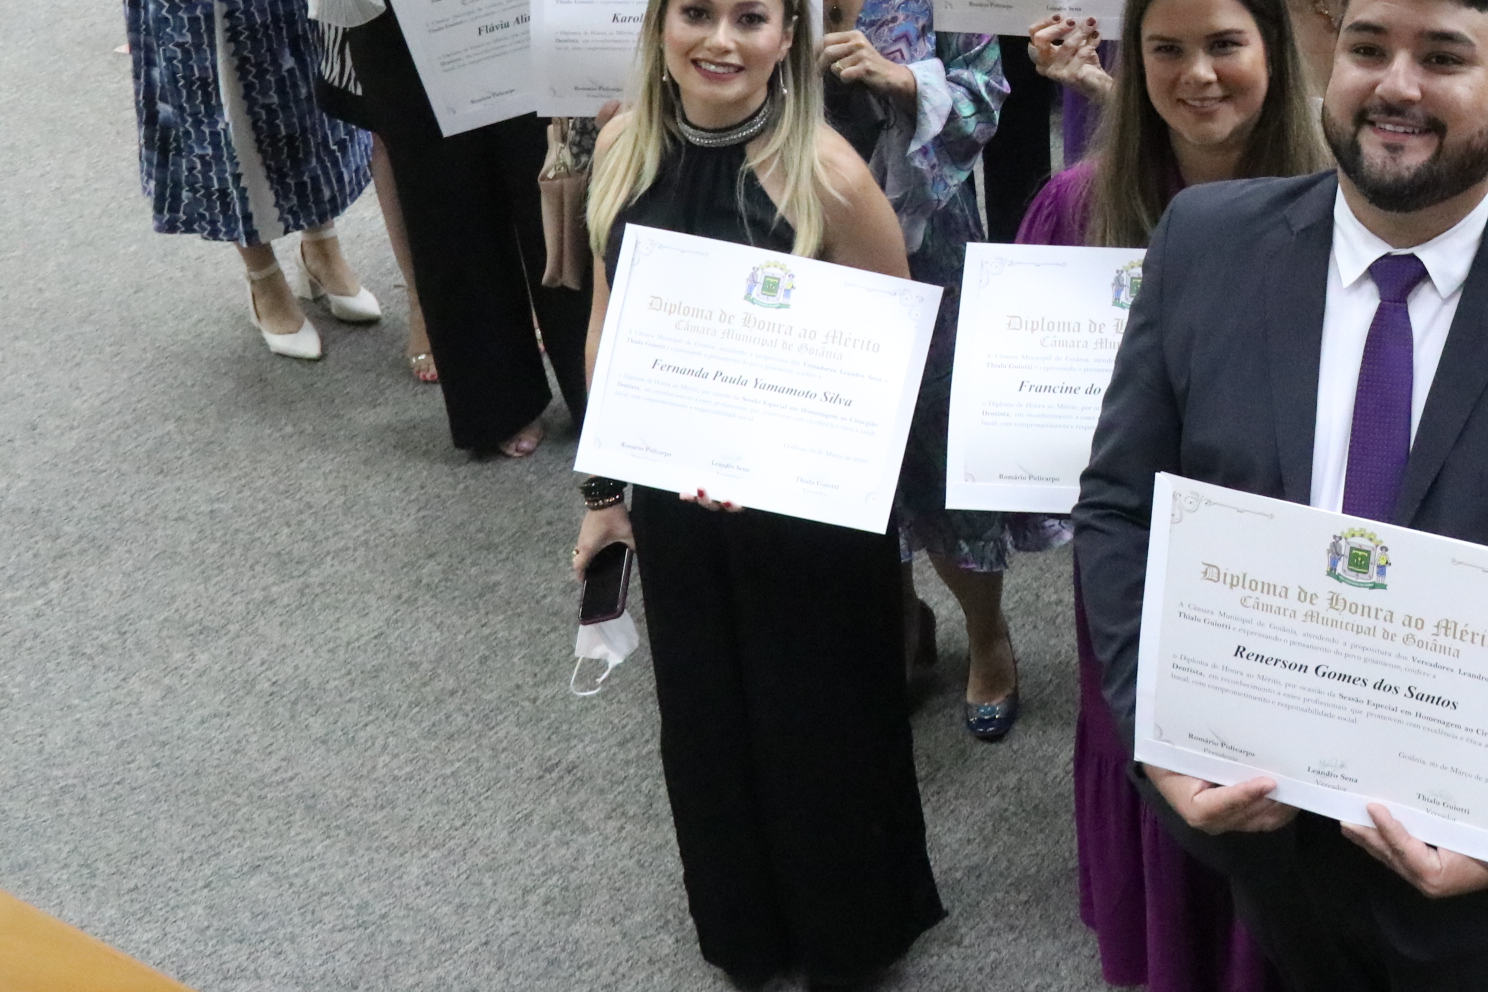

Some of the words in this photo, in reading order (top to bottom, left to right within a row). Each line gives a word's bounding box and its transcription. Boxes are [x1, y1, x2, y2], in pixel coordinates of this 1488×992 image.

[477, 20, 510, 37] Flávia
[648, 294, 712, 323] Diploma
[718, 310, 736, 326] de
[742, 311, 792, 337] Honra
[798, 326, 817, 341] ao
[822, 328, 880, 354] Mérito
[1006, 315, 1081, 334] Diploma
[1088, 319, 1106, 334] de
[1040, 336, 1088, 349] Câmara
[651, 358, 710, 382] Fernanda
[712, 370, 748, 388] Paula
[752, 377, 817, 401] Yamamoto
[820, 391, 853, 408] Silva
[1018, 380, 1081, 395] Francine
[1201, 561, 1289, 600] Diploma
[1297, 586, 1319, 606] de
[1326, 590, 1394, 625] Honra
[1402, 614, 1425, 631] ao
[1178, 611, 1201, 622] Thialu
[1203, 618, 1231, 630] Guiotti
[1238, 627, 1282, 643] expressando
[1289, 639, 1332, 655] pensamento
[1188, 603, 1214, 616] Câmara
[1218, 610, 1253, 625] Municipal
[1257, 620, 1266, 628] de
[1302, 631, 1339, 645] atendendo
[1350, 644, 1392, 657] propositura
[1396, 652, 1408, 661] dos
[1412, 656, 1454, 673] Vereadores
[1240, 596, 1297, 619] Câmara
[1301, 609, 1376, 638] Municipal
[1382, 627, 1397, 642] de
[1402, 633, 1461, 659] Goiânia
[1221, 676, 1276, 697] reconhecimento
[1233, 644, 1308, 674] Renerson
[1314, 663, 1369, 689] Gomes
[1373, 678, 1401, 696] dos
[1404, 685, 1459, 711] Santos
[1180, 654, 1209, 669] Diploma
[1222, 665, 1244, 676] Honra
[1299, 685, 1325, 698] ocasião
[1339, 691, 1364, 705] Sessão
[1367, 699, 1398, 713] Especial
[1415, 711, 1462, 730] Homenagem
[1207, 683, 1271, 705] comprometimento
[1188, 733, 1219, 747] Romário
[1221, 742, 1256, 757] Policarpo
[1307, 766, 1339, 779] Leandro
[1340, 772, 1358, 784] Sena
[1450, 766, 1473, 779] Março
[1416, 792, 1441, 806] Thialu
[1442, 800, 1470, 815] Guiotti
